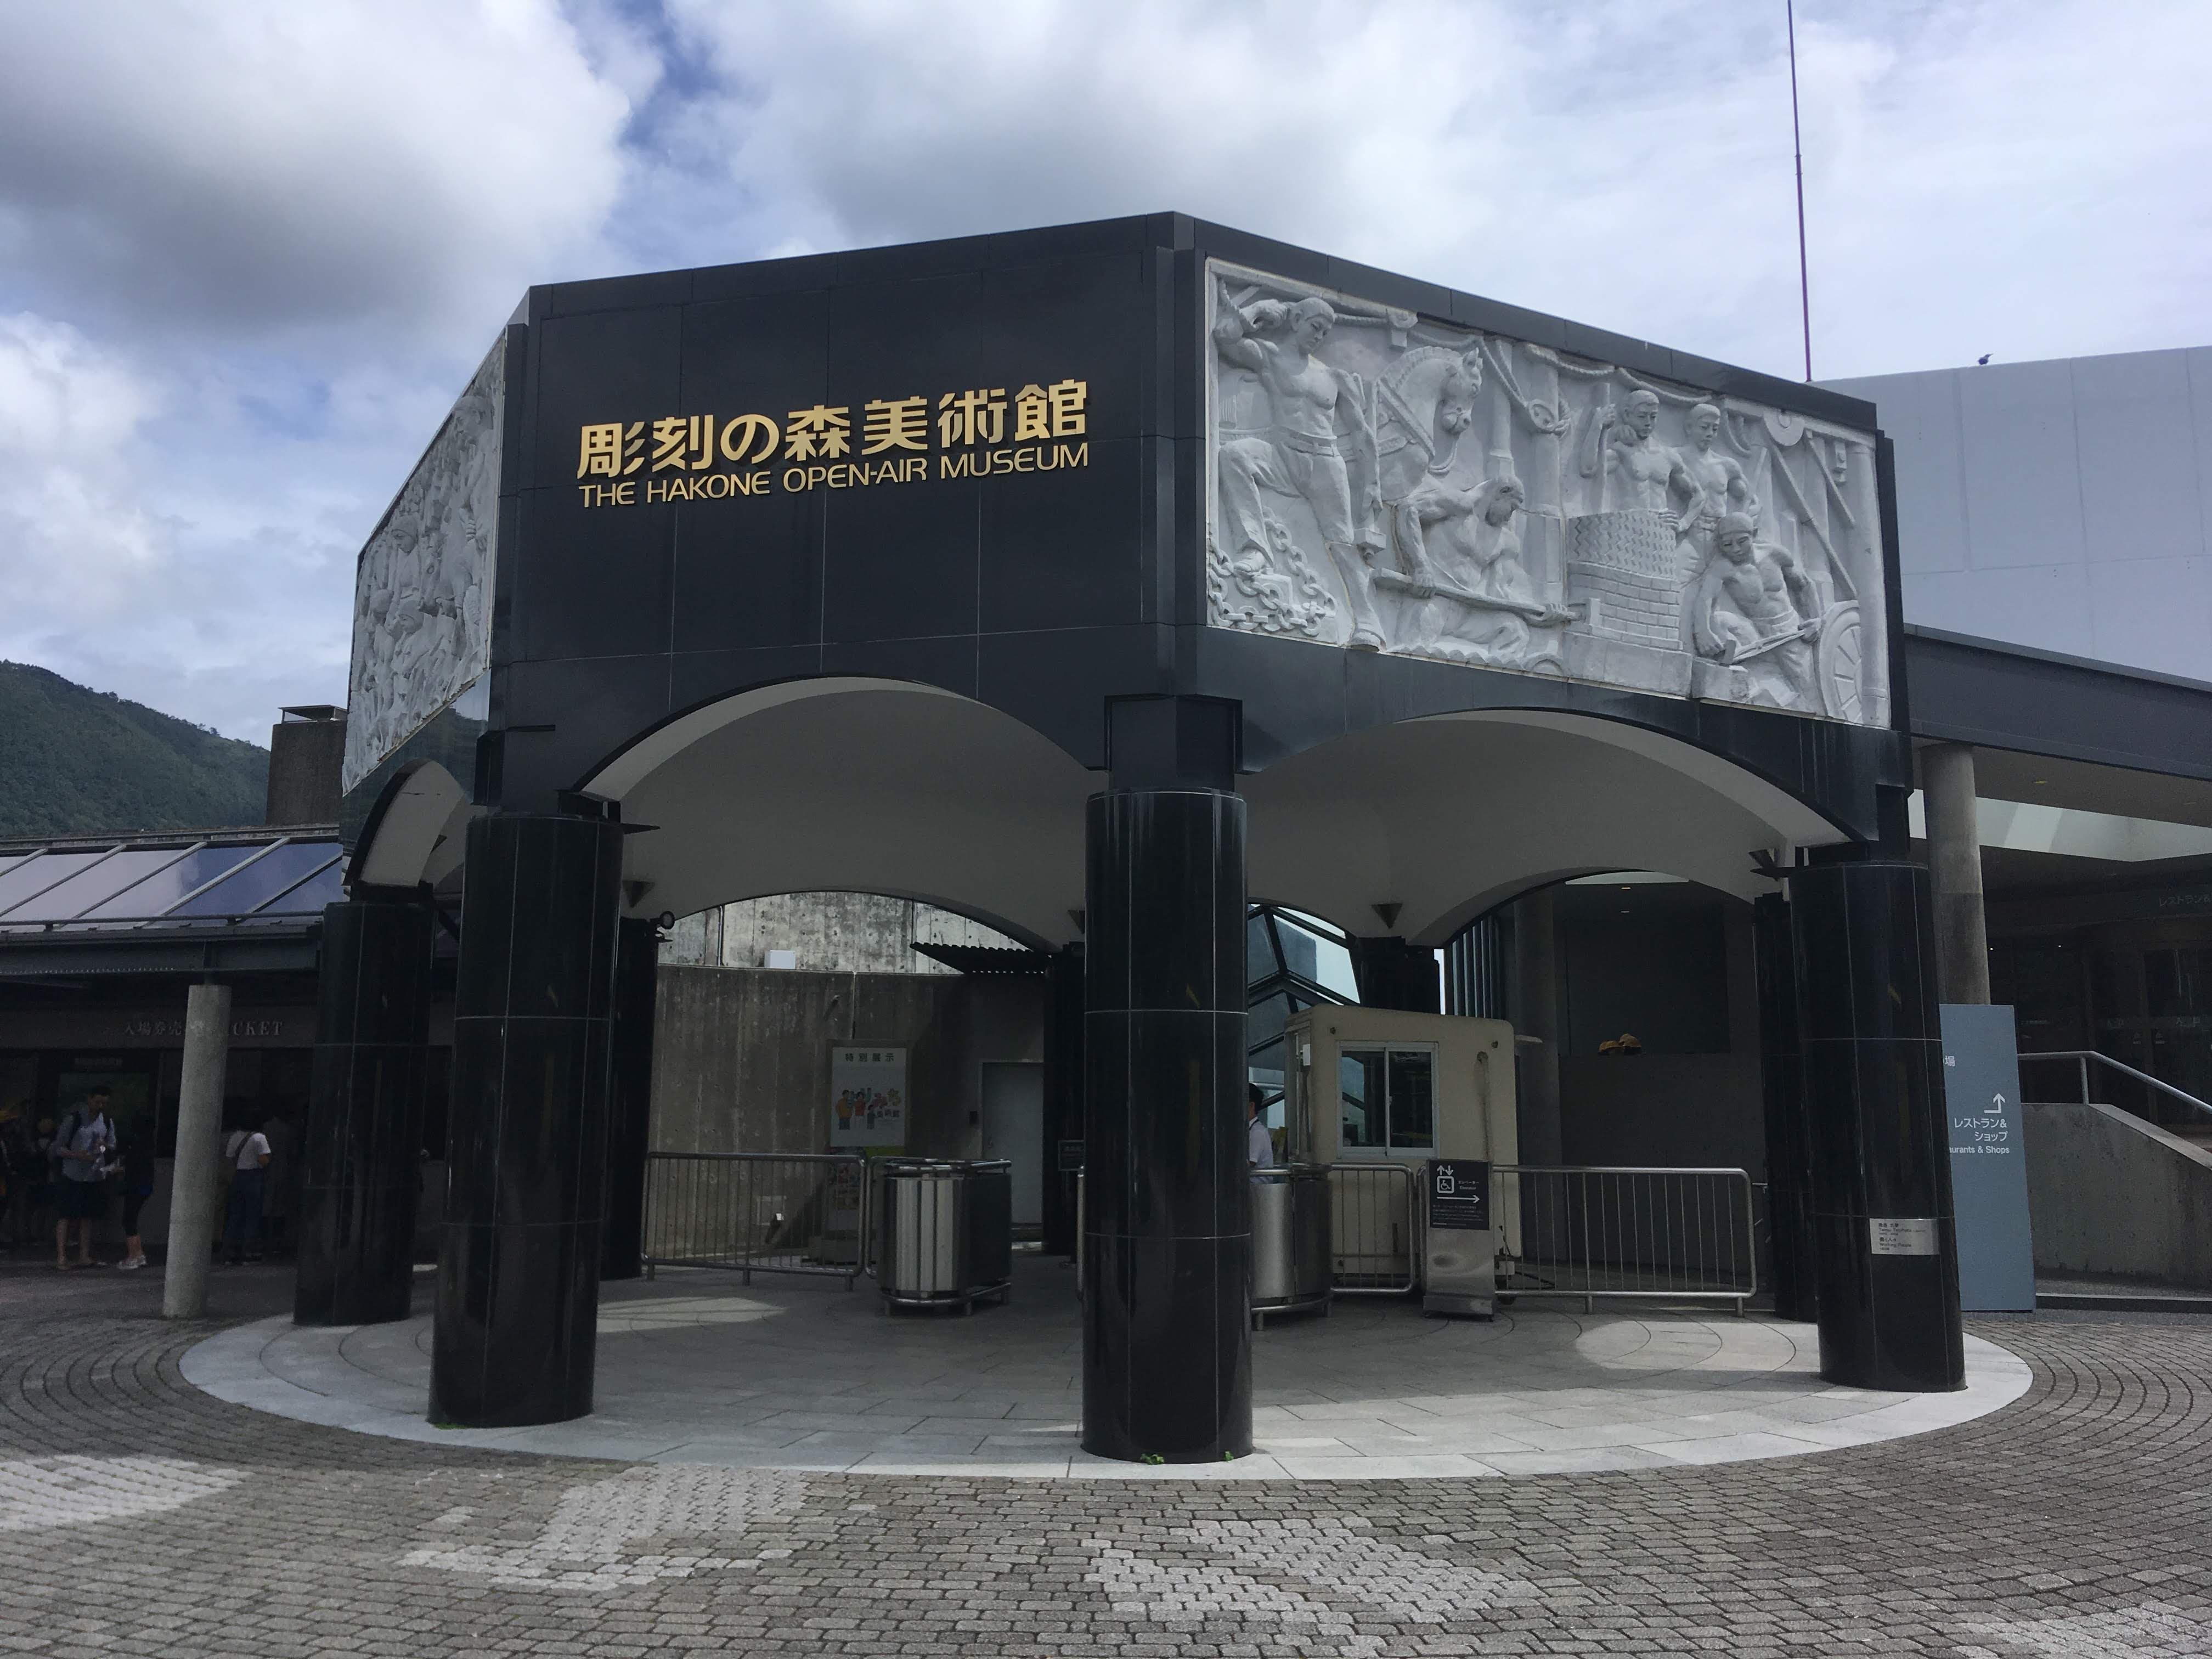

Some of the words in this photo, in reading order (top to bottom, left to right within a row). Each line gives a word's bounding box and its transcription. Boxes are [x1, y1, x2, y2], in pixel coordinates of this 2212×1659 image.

[577, 379, 1087, 479] 彫刻の森美術館
[578, 481, 636, 508] THE
[647, 471, 771, 504] HAKONE
[783, 458, 928, 493] OPEN-AIR
[940, 442, 1088, 479] MUSEUM
[233, 1019, 284, 1036] CKET
[1943, 1055, 1956, 1067] 場
[1954, 1117, 2007, 1128] レストラン&
[1974, 1130, 2008, 1142] ショップ
[1949, 1146, 1975, 1154] aurants
[1977, 1146, 1983, 1154] &
[1985, 1145, 2010, 1155] Shops
